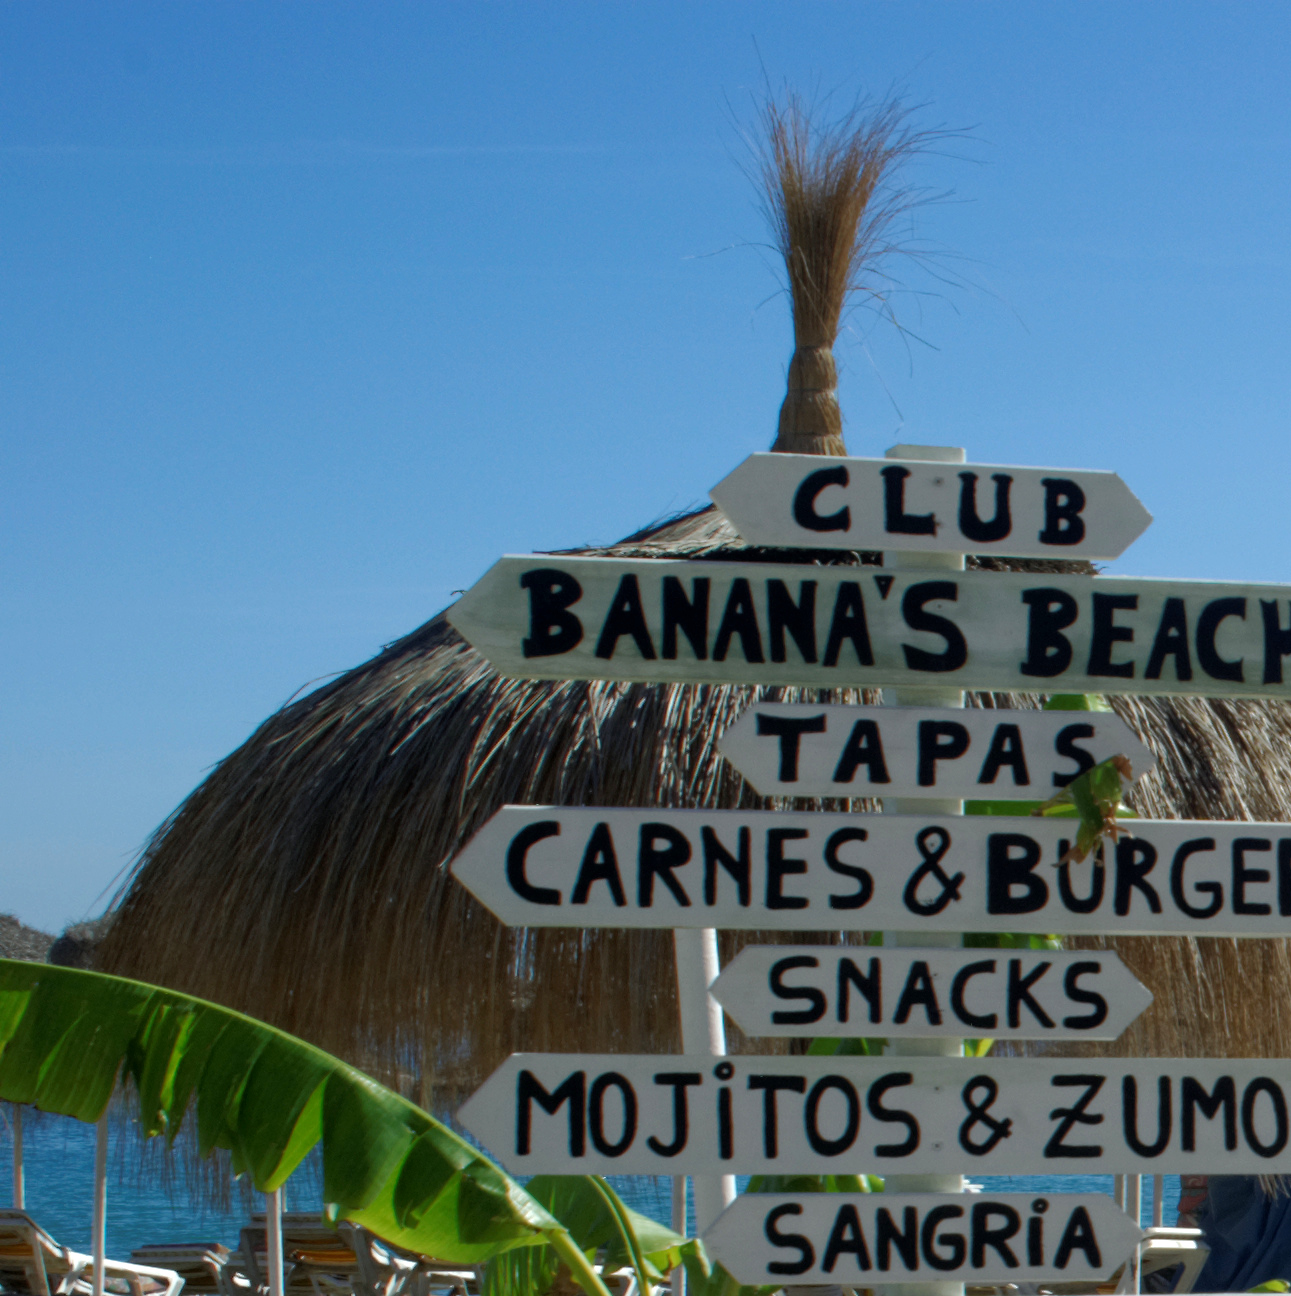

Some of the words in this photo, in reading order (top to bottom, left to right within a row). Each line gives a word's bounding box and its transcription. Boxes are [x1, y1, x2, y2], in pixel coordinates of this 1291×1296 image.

[791, 465, 1086, 546] CLUB
[520, 568, 968, 672] BANANA'S
[755, 712, 1097, 787] TAPAS
[504, 819, 875, 911] CARNES
[902, 825, 966, 916] &
[768, 955, 1109, 1029] SNACKS
[958, 1074, 1012, 1157] &
